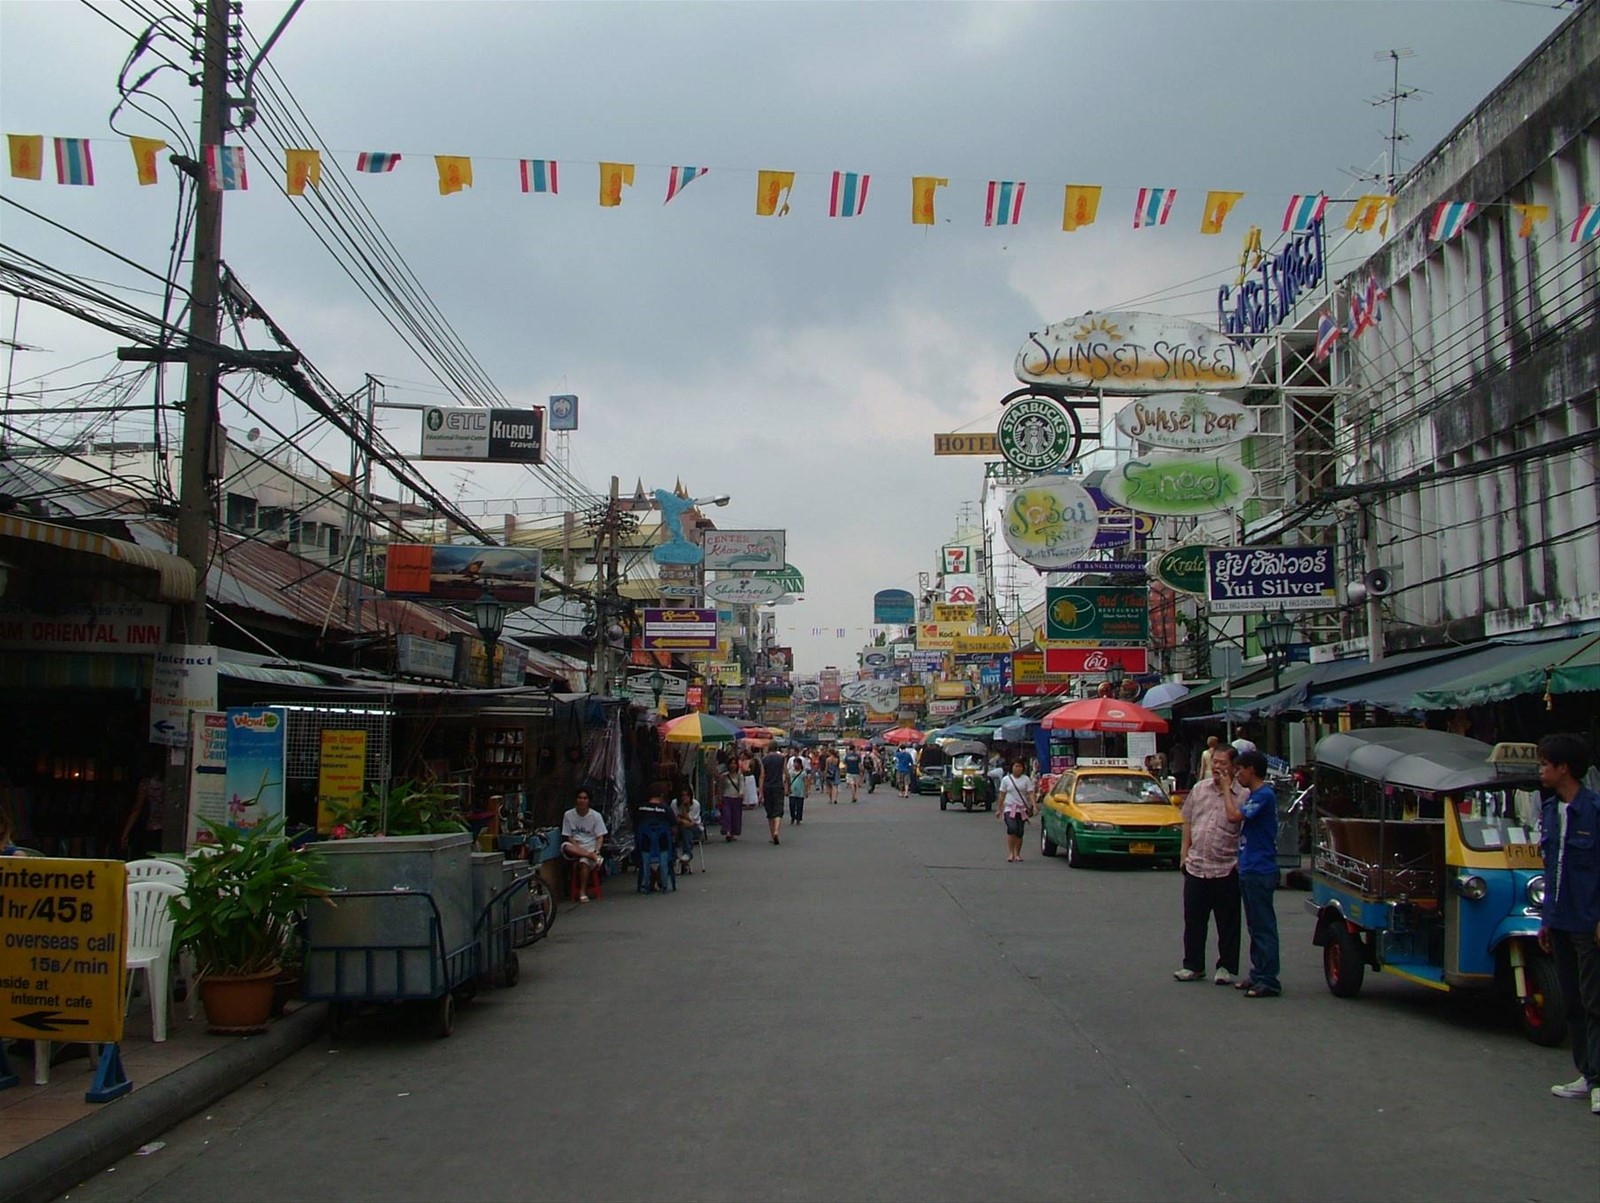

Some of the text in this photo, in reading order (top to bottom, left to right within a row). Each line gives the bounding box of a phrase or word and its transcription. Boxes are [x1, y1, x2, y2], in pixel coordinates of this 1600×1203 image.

[1153, 340, 1237, 383] STREET
[446, 412, 487, 431] ETC
[1003, 402, 1067, 435] STARBUCKS
[1203, 410, 1243, 435] Bar
[510, 440, 540, 451] travels
[1009, 447, 1060, 467] COFFEE
[706, 533, 752, 546] CENTER
[715, 584, 774, 596] Shamrock
[1222, 579, 1326, 599] Yui Silver
[31, 621, 118, 643] ORIENTAL
[126, 623, 161, 644] INN
[1501, 746, 1537, 760] TAXI
[5, 932, 116, 952] overseas call
[36, 979, 49, 992] at
[11, 990, 94, 1009] internet cafe
